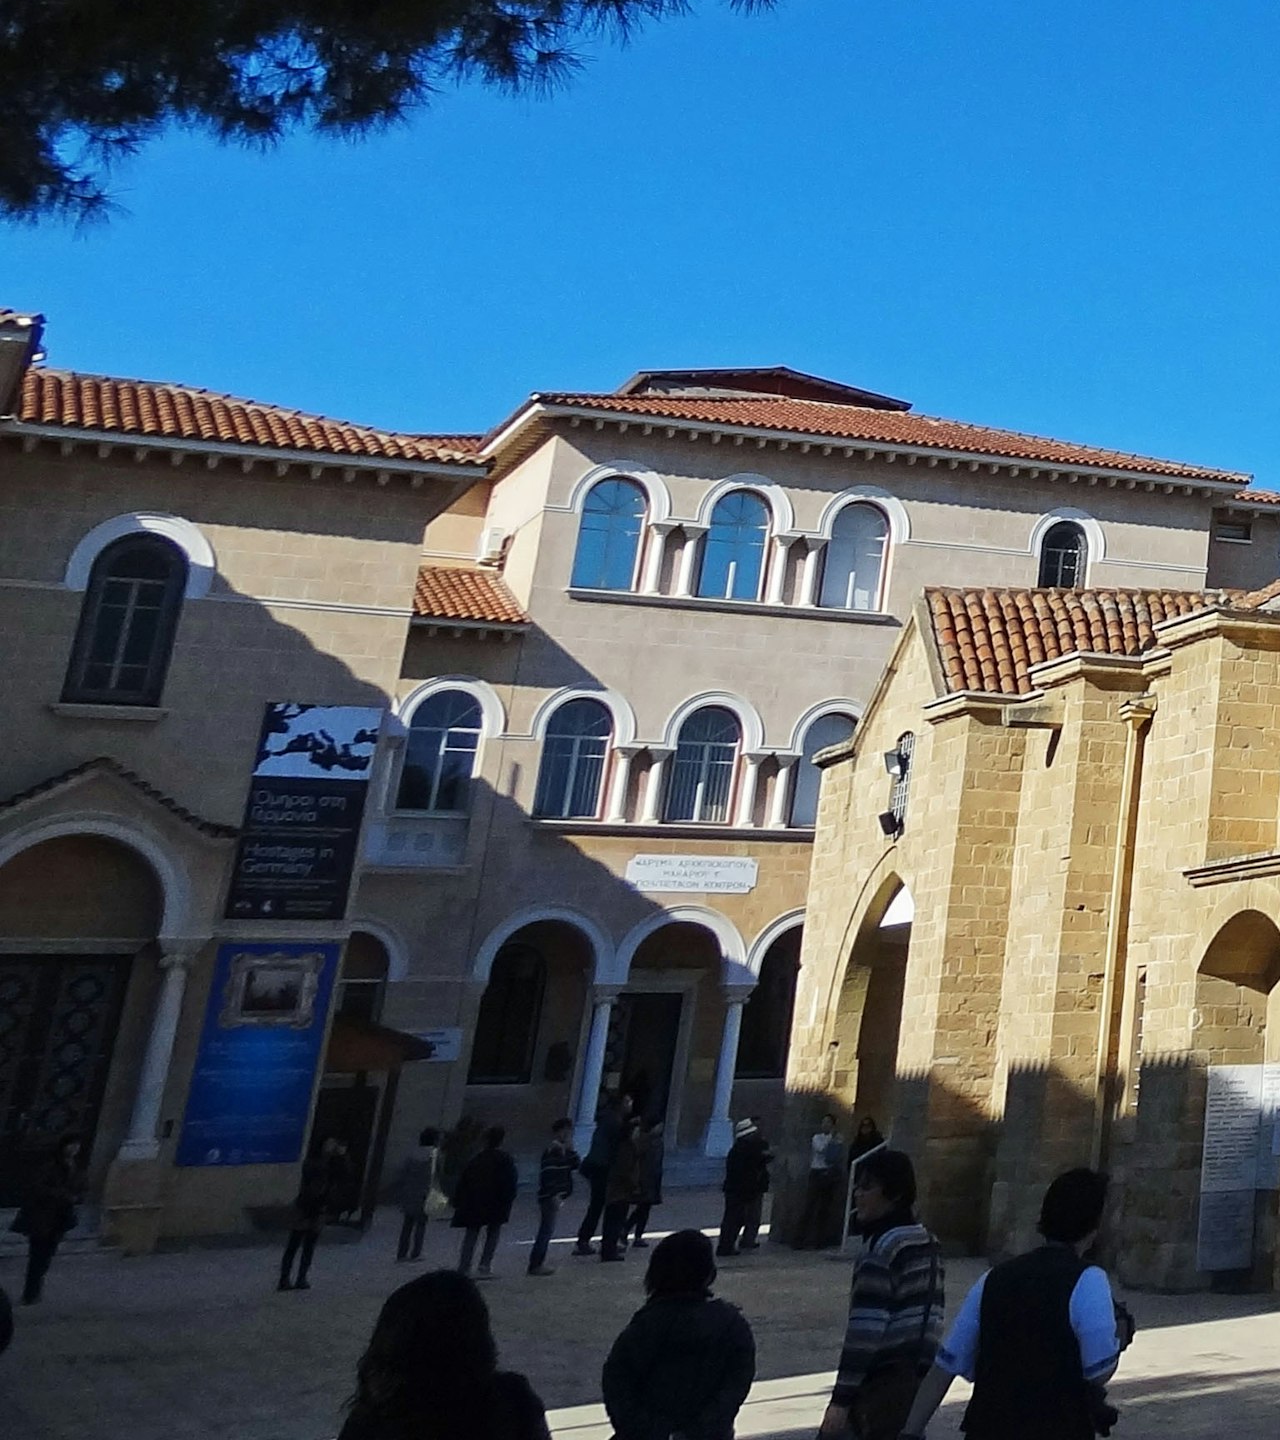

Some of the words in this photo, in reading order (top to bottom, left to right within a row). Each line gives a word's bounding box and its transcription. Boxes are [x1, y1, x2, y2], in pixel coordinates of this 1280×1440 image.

[244, 845, 316, 860] Hostages
[320, 847, 334, 858] in
[241, 858, 313, 877] Germany
